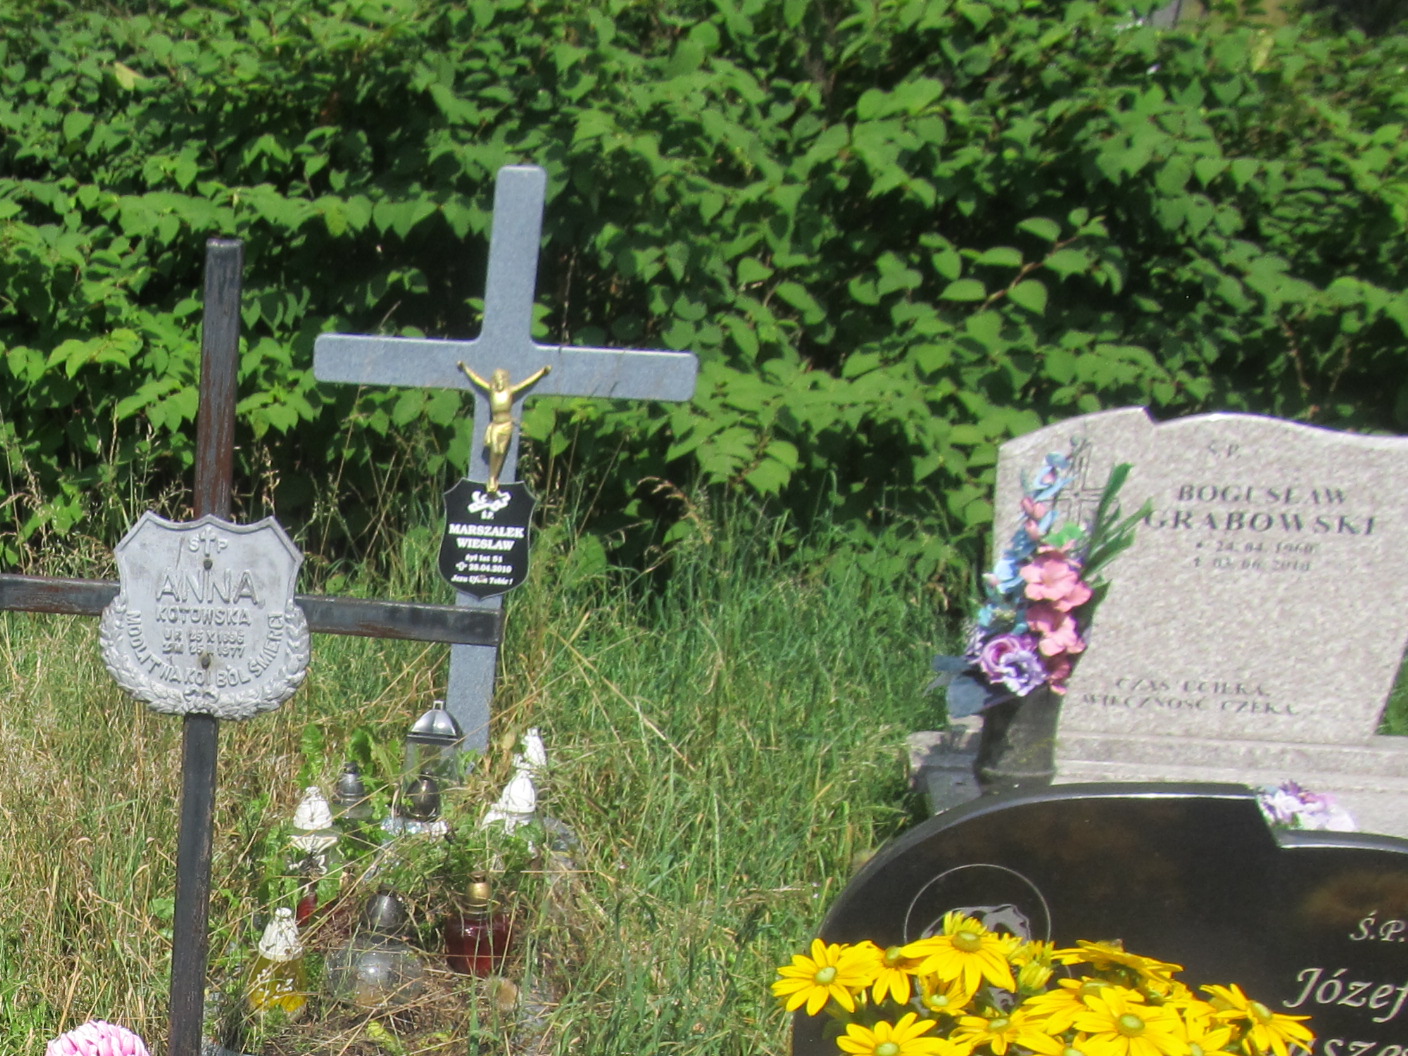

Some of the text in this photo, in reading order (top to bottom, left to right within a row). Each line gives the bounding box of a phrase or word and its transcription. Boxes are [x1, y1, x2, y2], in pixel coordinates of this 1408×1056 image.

[1142, 508, 1377, 536] GRABOWSKI
[156, 567, 261, 606] ANNA
[156, 606, 252, 626] KOTOWSKA
[1349, 909, 1408, 943] Ś.P.
[1282, 967, 1408, 1023] Józef
